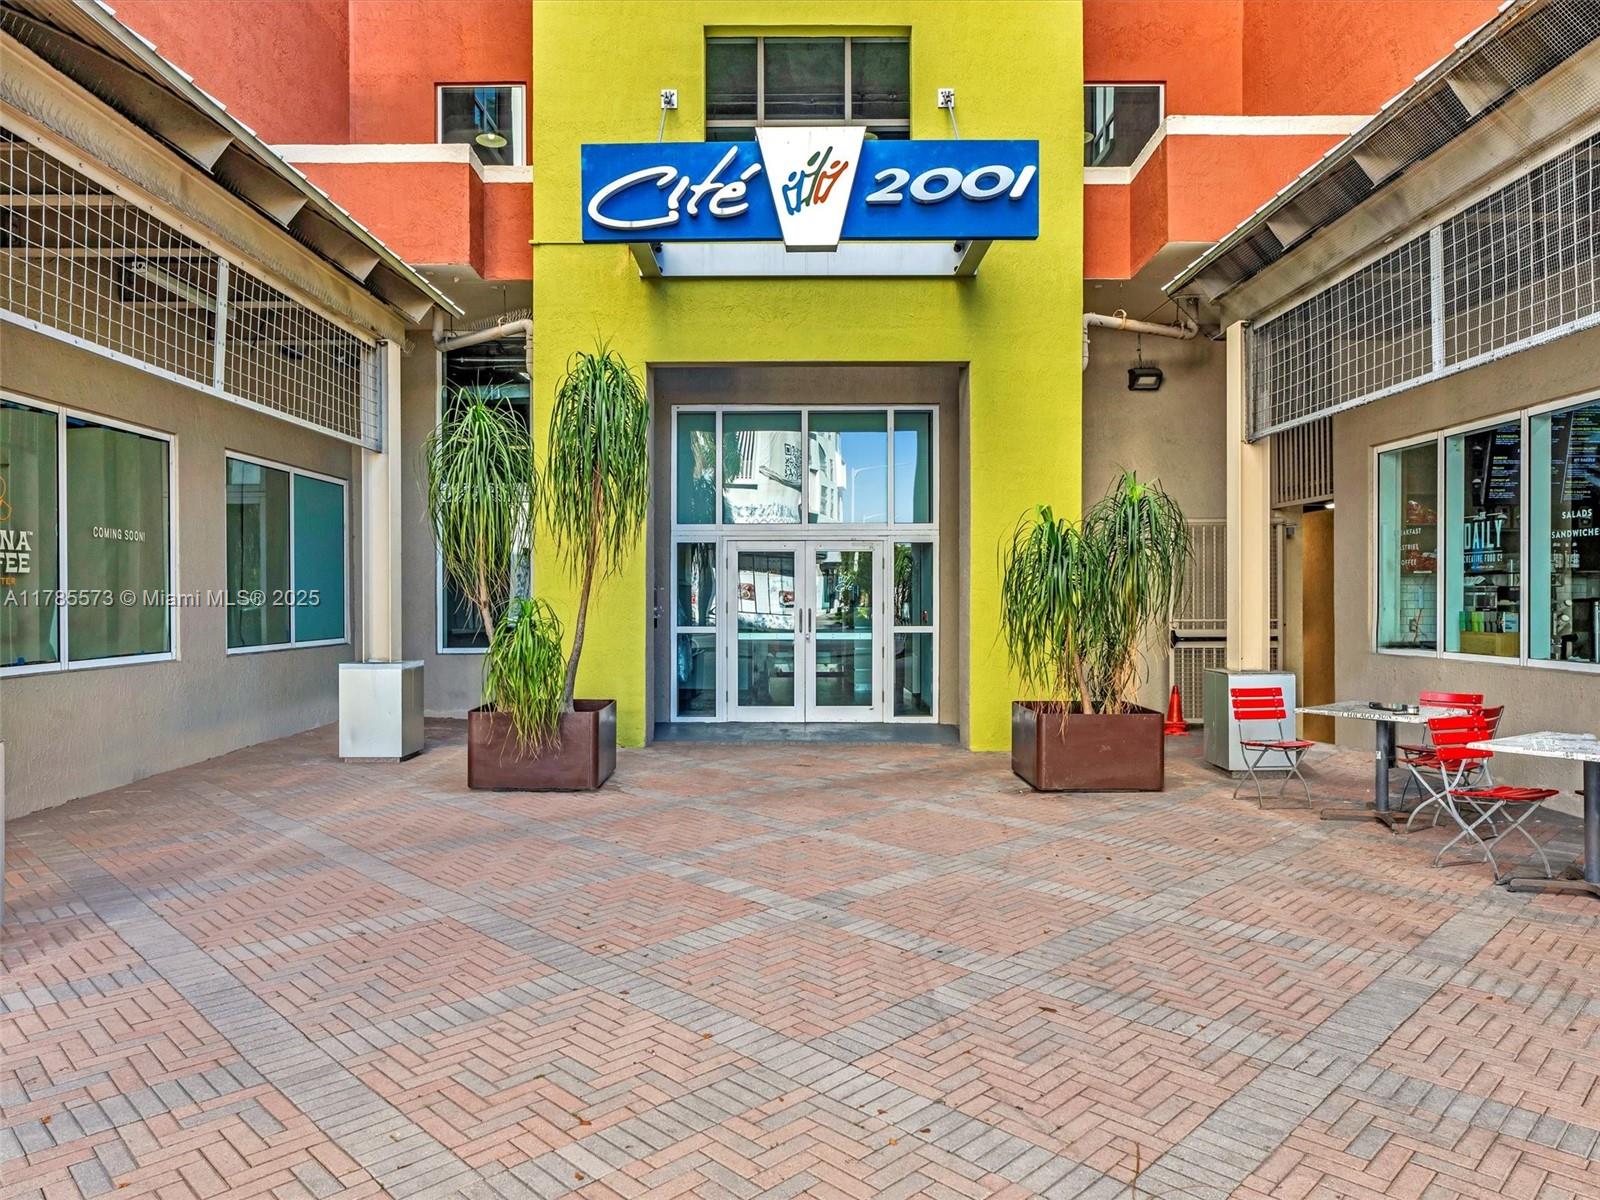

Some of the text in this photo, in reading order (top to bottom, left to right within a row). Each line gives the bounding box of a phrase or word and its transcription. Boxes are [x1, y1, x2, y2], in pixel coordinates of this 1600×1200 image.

[587, 145, 1037, 231] Cité 2001
[1561, 508, 1593, 520] SALADS
[92, 526, 122, 540] COMING
[1464, 518, 1503, 550] DAILY
[1551, 527, 1600, 539] SANDWICHE
